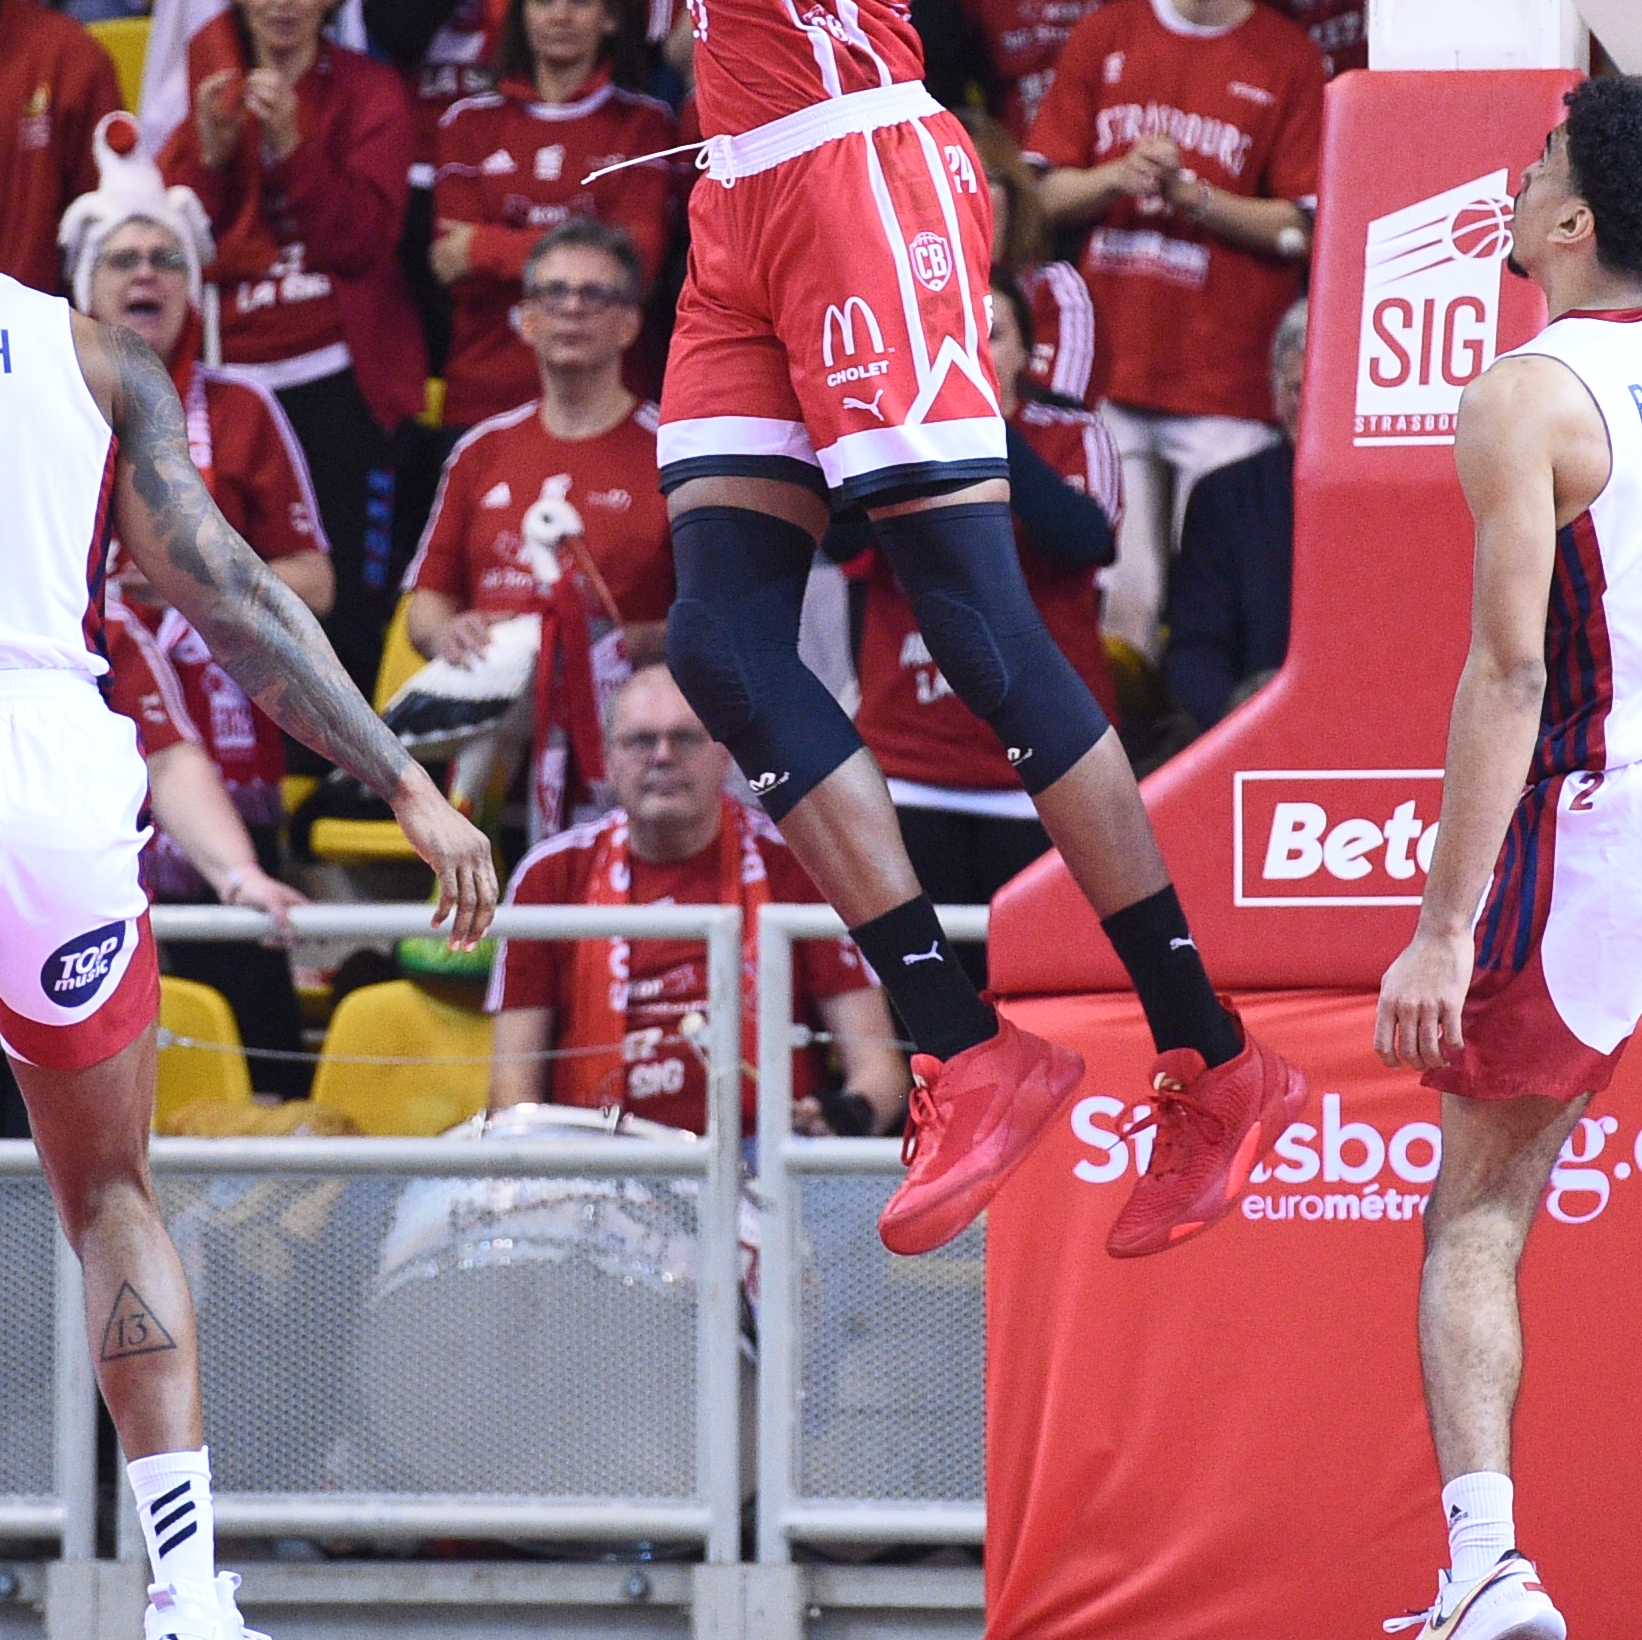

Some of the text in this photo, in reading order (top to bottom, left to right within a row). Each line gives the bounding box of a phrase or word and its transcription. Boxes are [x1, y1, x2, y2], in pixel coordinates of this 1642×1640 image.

[1369, 295, 1486, 388] SIG
[826, 359, 890, 388] CHOLET
[1568, 771, 1605, 811] 2
[53, 959, 109, 992] music
[59, 936, 118, 979] TOP
